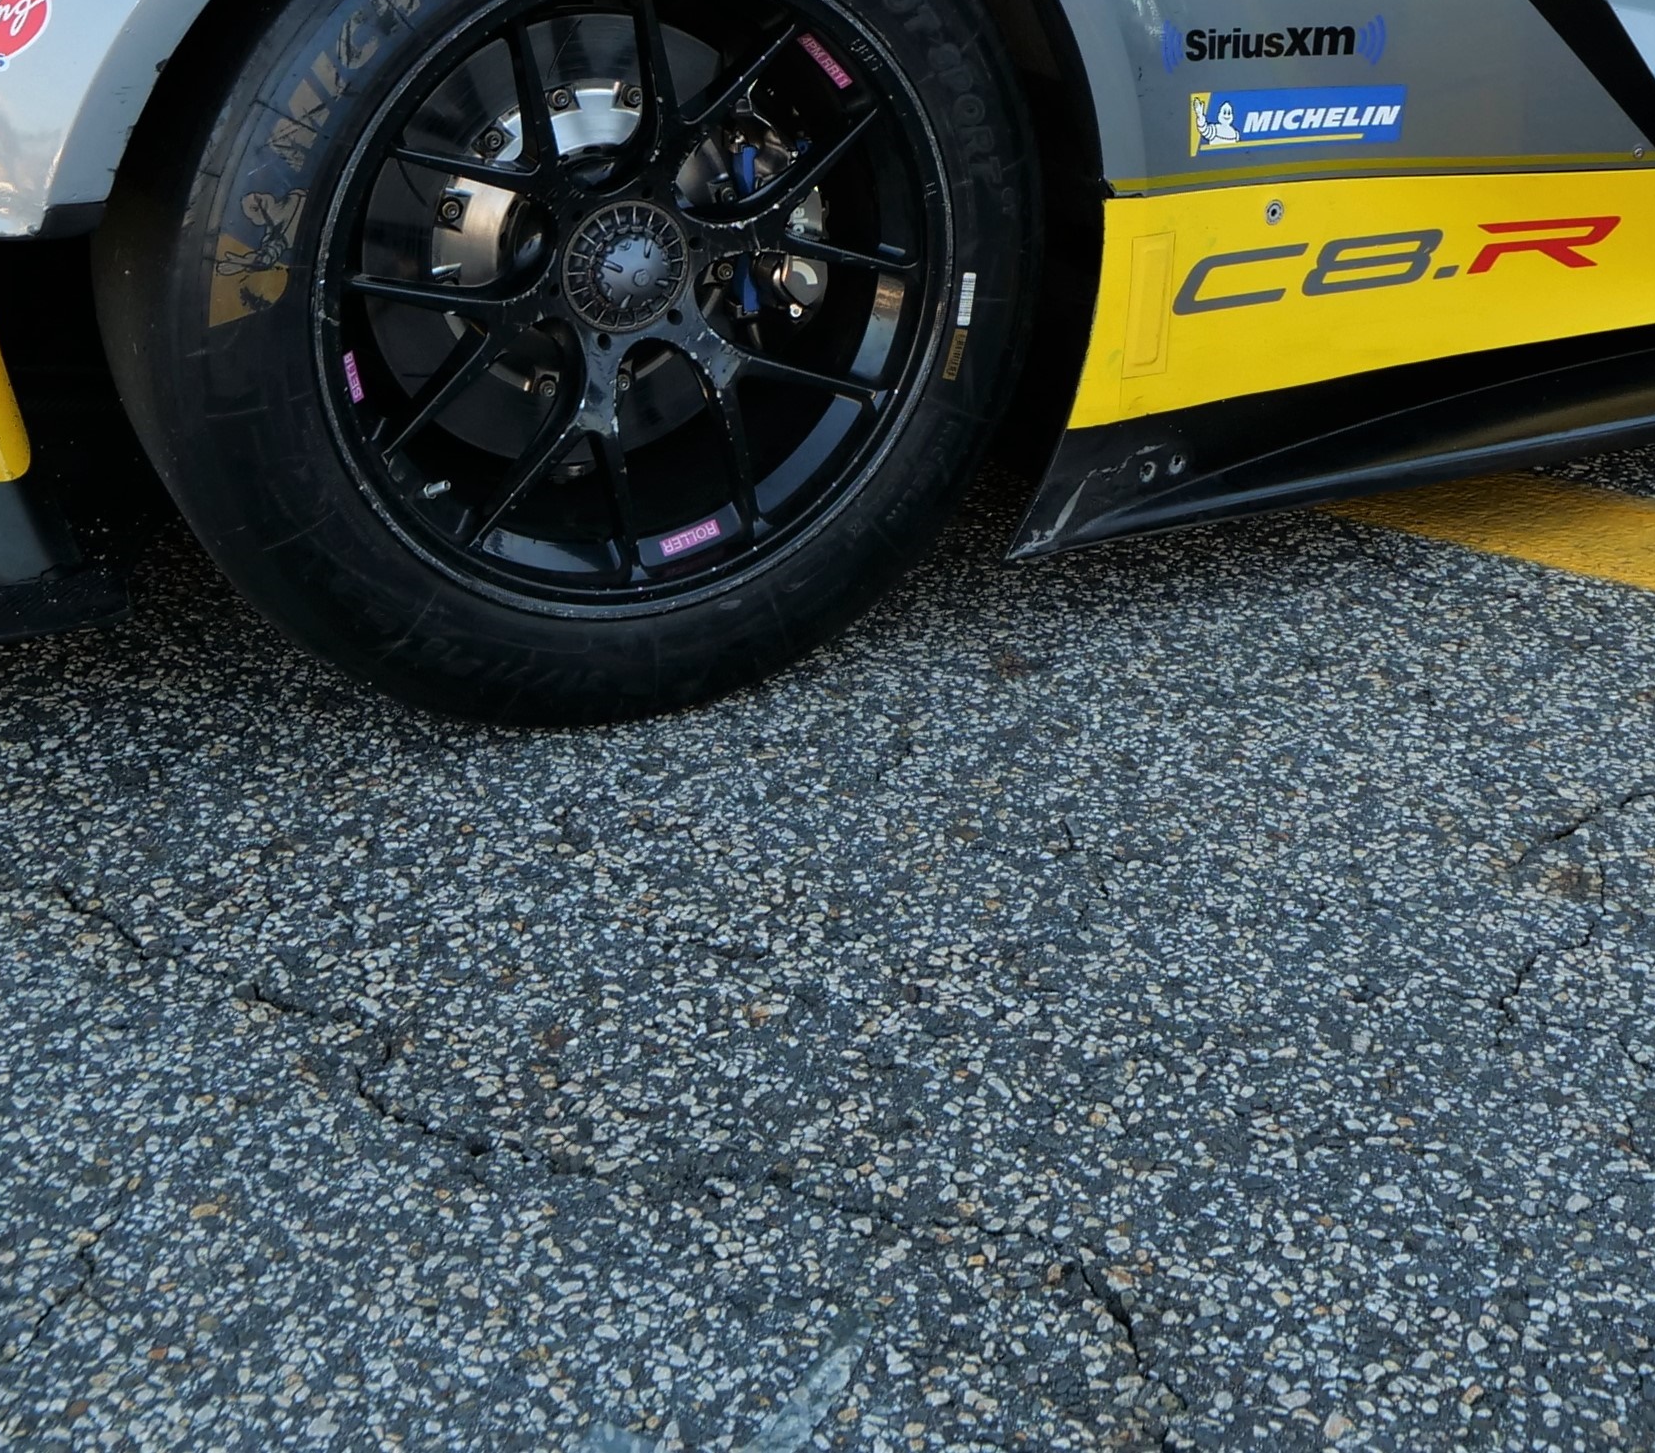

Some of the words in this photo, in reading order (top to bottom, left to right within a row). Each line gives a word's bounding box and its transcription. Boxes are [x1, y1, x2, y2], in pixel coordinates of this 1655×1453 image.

[1185, 25, 1356, 62] SiriusXM
[1242, 104, 1402, 133] MICHELIN
[1171, 215, 1622, 316] C8.R
[662, 522, 718, 554] ROLLER
